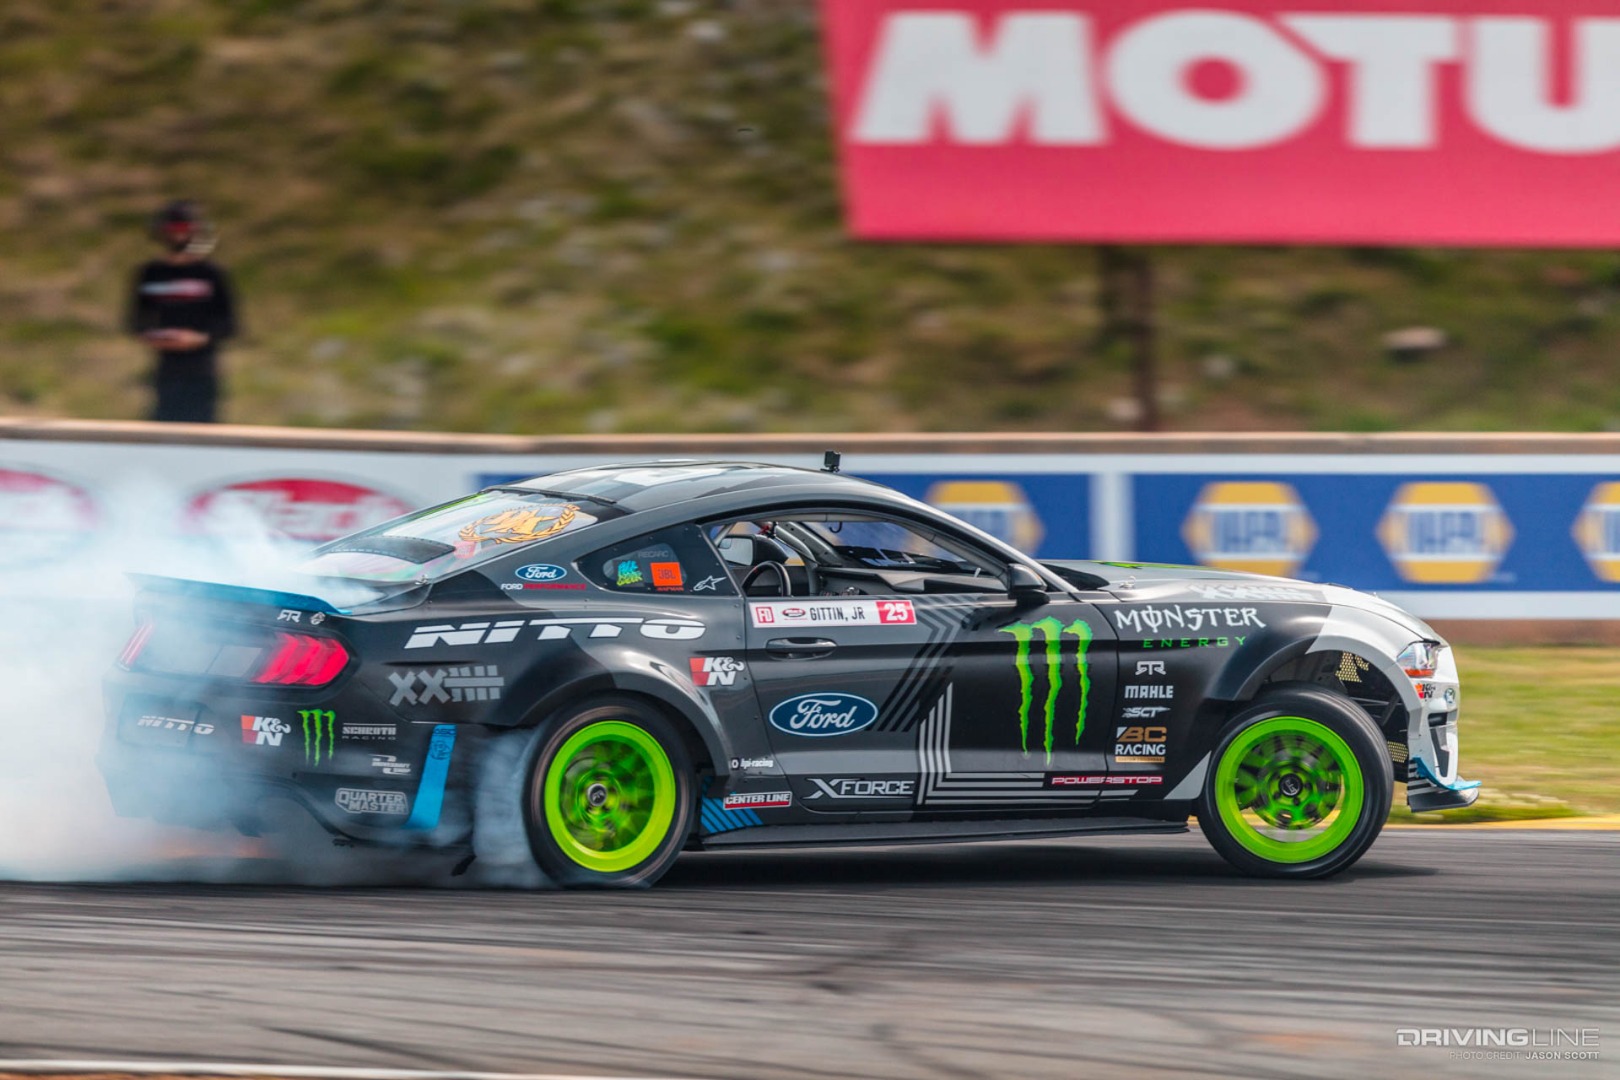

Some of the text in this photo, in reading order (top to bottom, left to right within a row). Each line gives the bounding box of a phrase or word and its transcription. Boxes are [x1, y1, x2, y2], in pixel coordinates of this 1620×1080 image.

[525, 566, 557, 578] Ford
[810, 607, 848, 622] GITTIN,
[851, 606, 866, 620] JR
[886, 603, 908, 621] 25
[404, 617, 706, 650] NITTO
[1143, 636, 1247, 648] ENERGY
[704, 657, 746, 686] K&N
[1124, 685, 1174, 699] MAHLE
[789, 699, 858, 729] Ford
[1129, 706, 1160, 718] SCT
[251, 716, 291, 746] K&N
[1118, 727, 1167, 742] BC
[1115, 744, 1166, 755] RACING
[340, 791, 403, 803] QUARTER
[725, 793, 790, 804] CENTER LINE
[349, 802, 405, 812] MASTER
